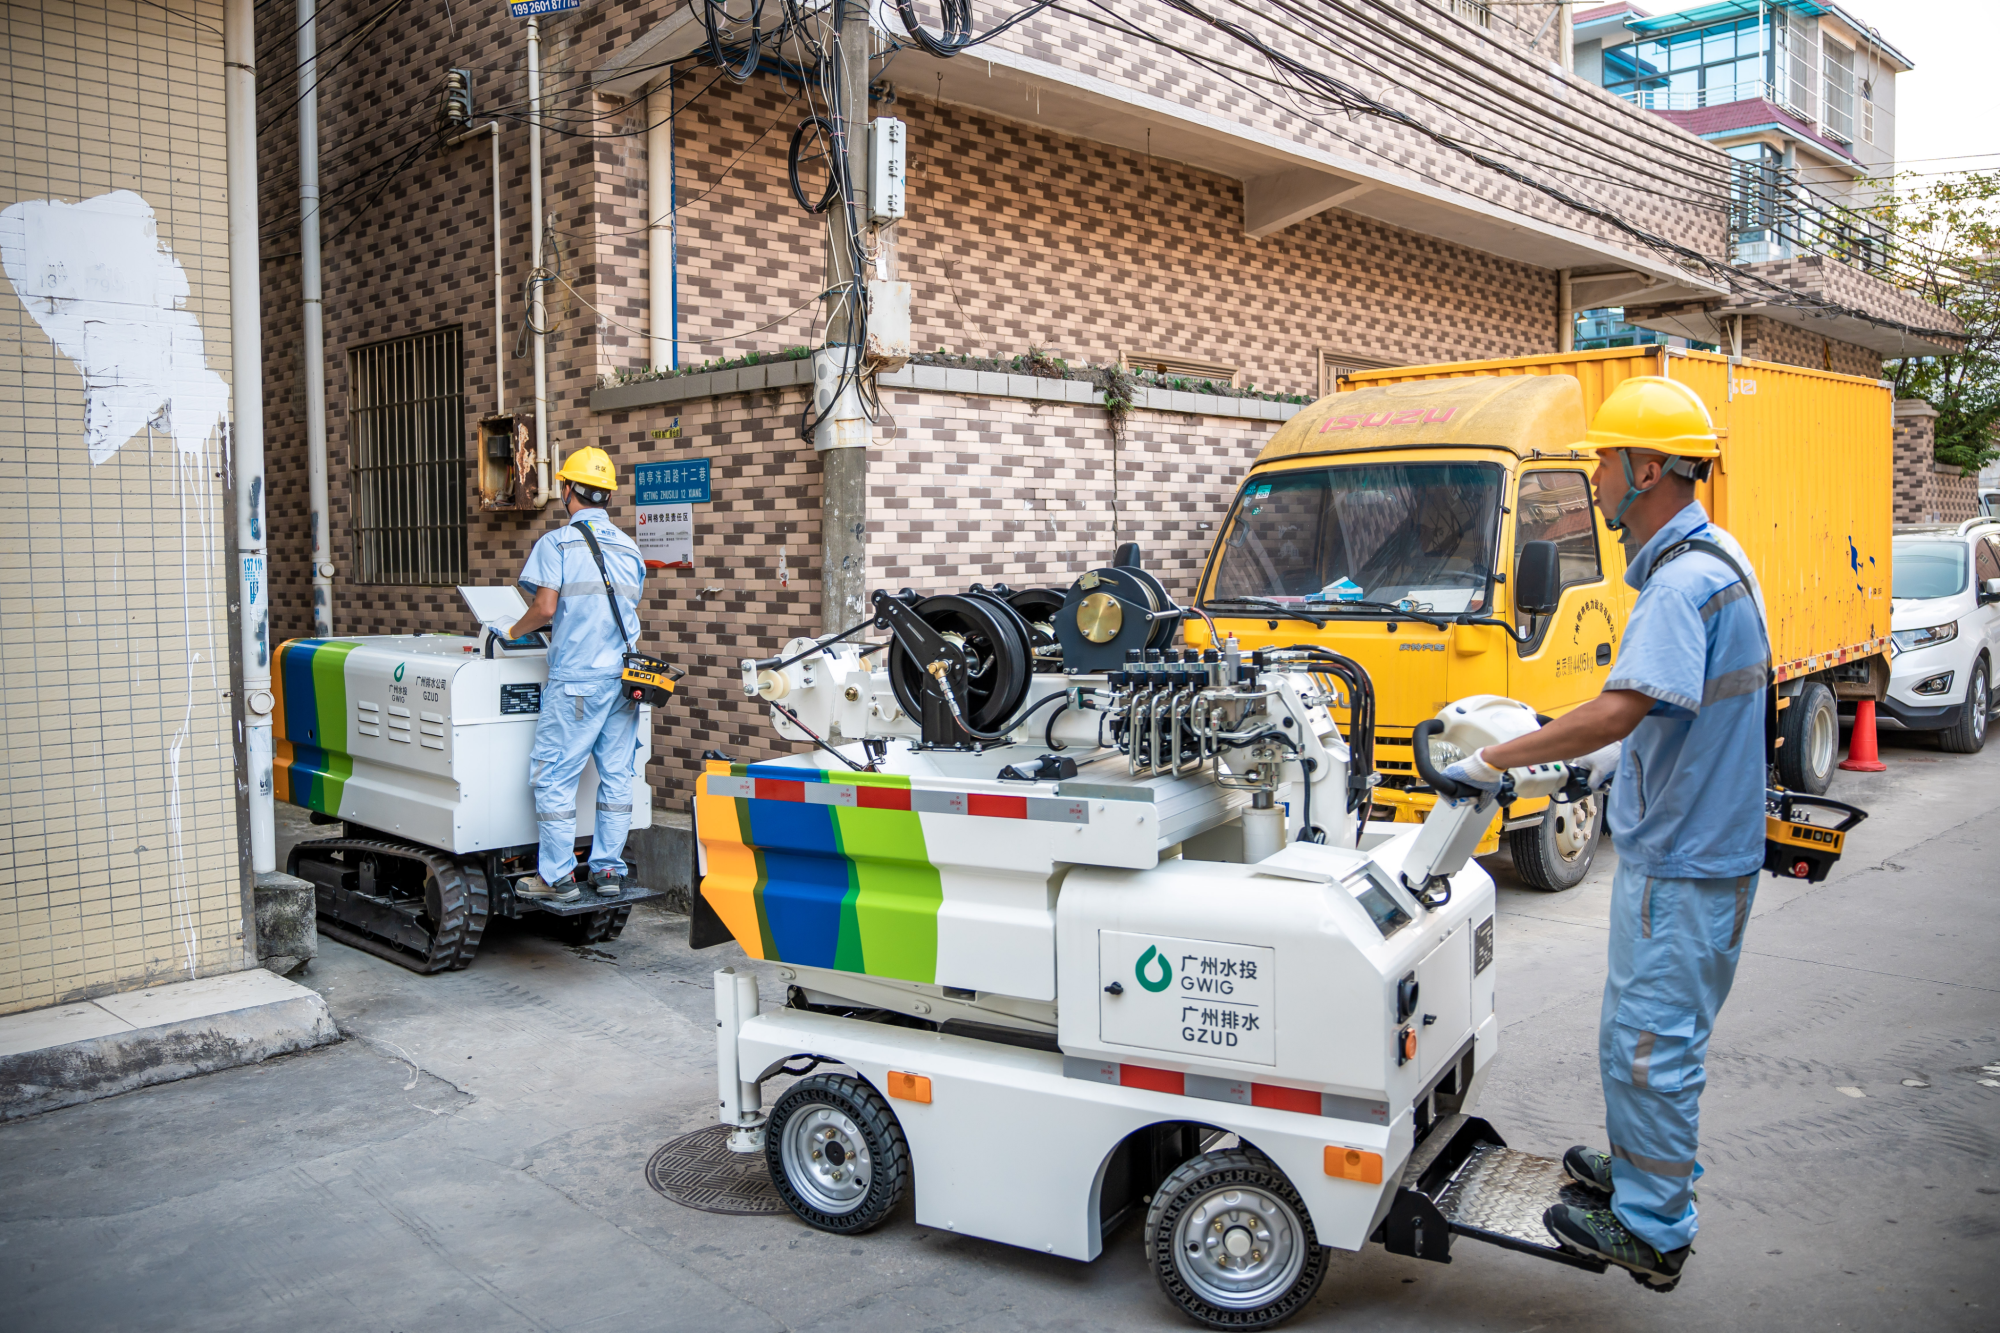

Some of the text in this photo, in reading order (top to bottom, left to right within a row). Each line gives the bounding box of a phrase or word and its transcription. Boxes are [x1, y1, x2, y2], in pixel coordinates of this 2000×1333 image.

[513, 3, 528, 15] 199
[529, 0, 550, 13] 2601
[1319, 407, 1458, 433] ISUZU
[595, 465, 607, 473] 北区
[638, 466, 706, 486] 鹤亭洙泗路十二巷
[643, 488, 702, 501] HETING ZHUSILU 12 XIANG
[647, 512, 688, 523] 网格党员责任区
[244, 557, 253, 571] 137
[389, 684, 408, 696] 广州水投
[416, 675, 446, 690] 广州排水公司
[392, 694, 405, 704] GWIG
[423, 691, 439, 702] GZUD
[1181, 954, 1258, 980] 广州水投
[1181, 976, 1234, 995] GWIG
[1181, 1006, 1260, 1031] 广州排水
[1182, 1027, 1238, 1047] GZUD
